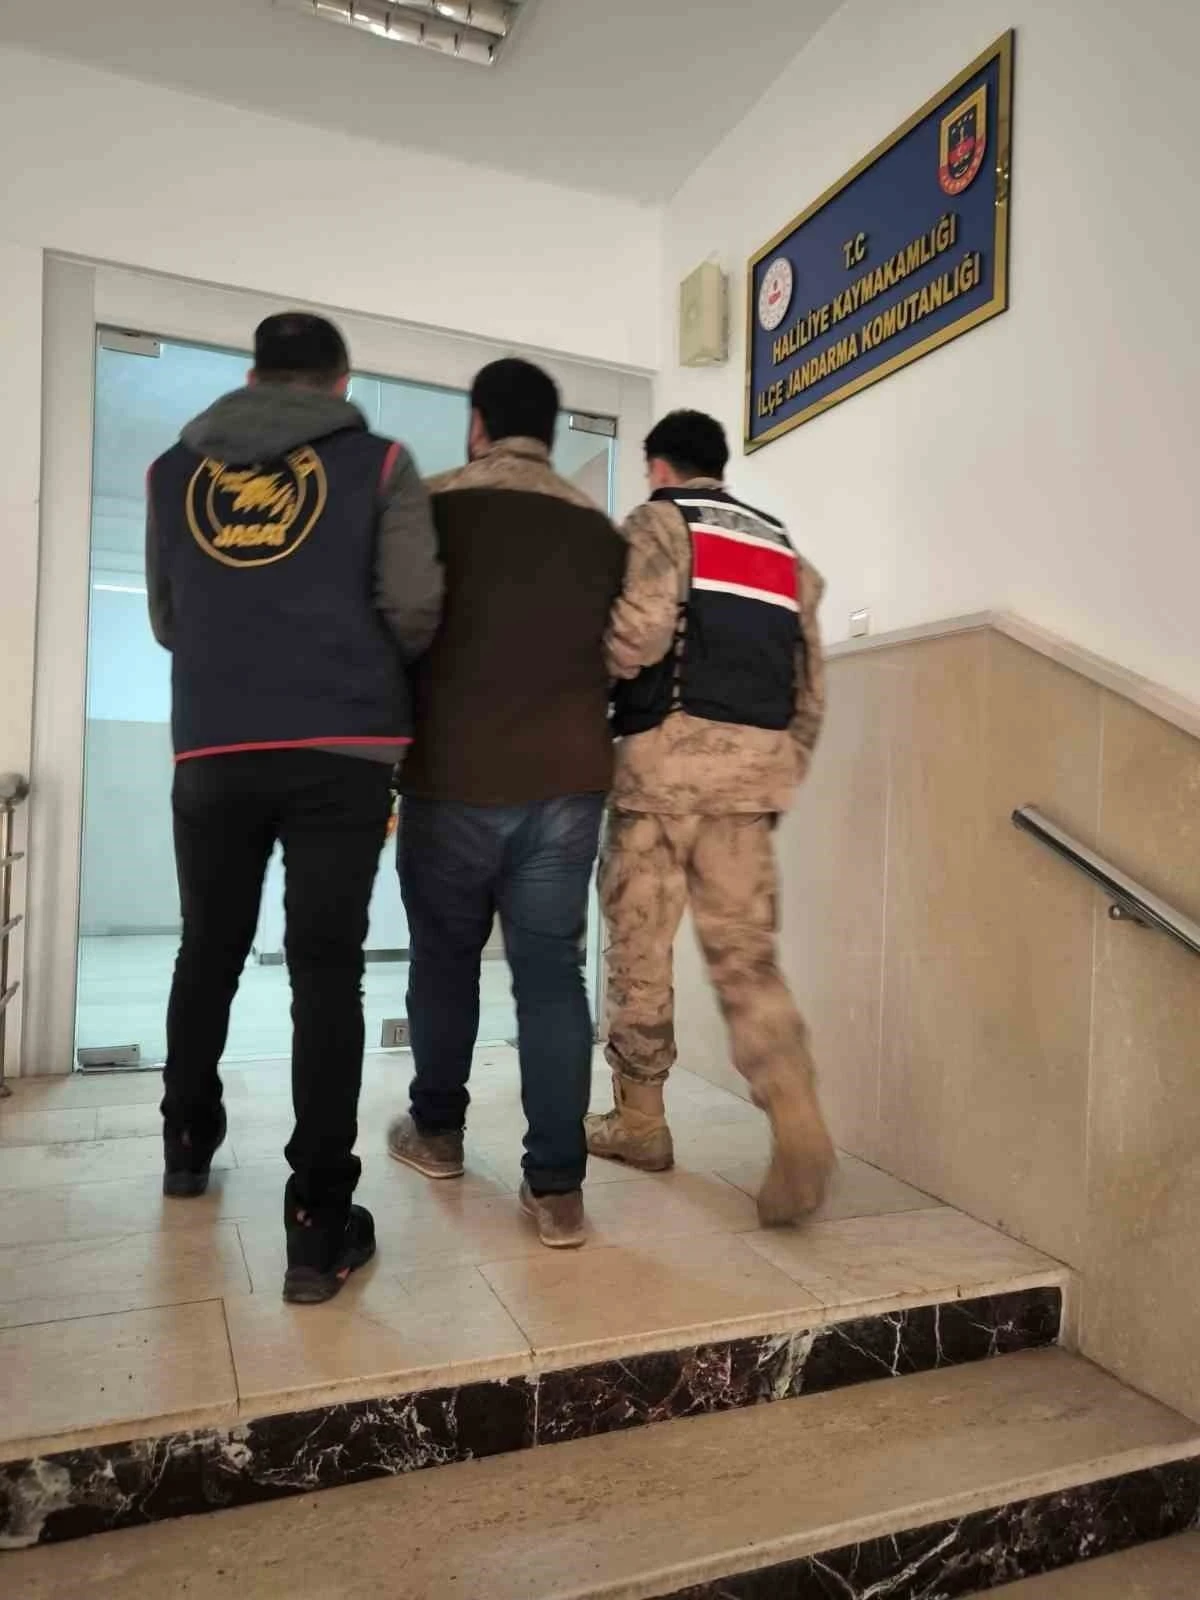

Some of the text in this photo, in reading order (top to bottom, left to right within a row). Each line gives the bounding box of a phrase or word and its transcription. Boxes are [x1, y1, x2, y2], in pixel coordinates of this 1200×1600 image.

[773, 213, 956, 364] HALİLİYE KAYMAKAMLIĞI
[843, 231, 865, 269] T.C
[786, 333, 857, 399] JANDARMA
[861, 252, 980, 353] KOMUTANLIĞI
